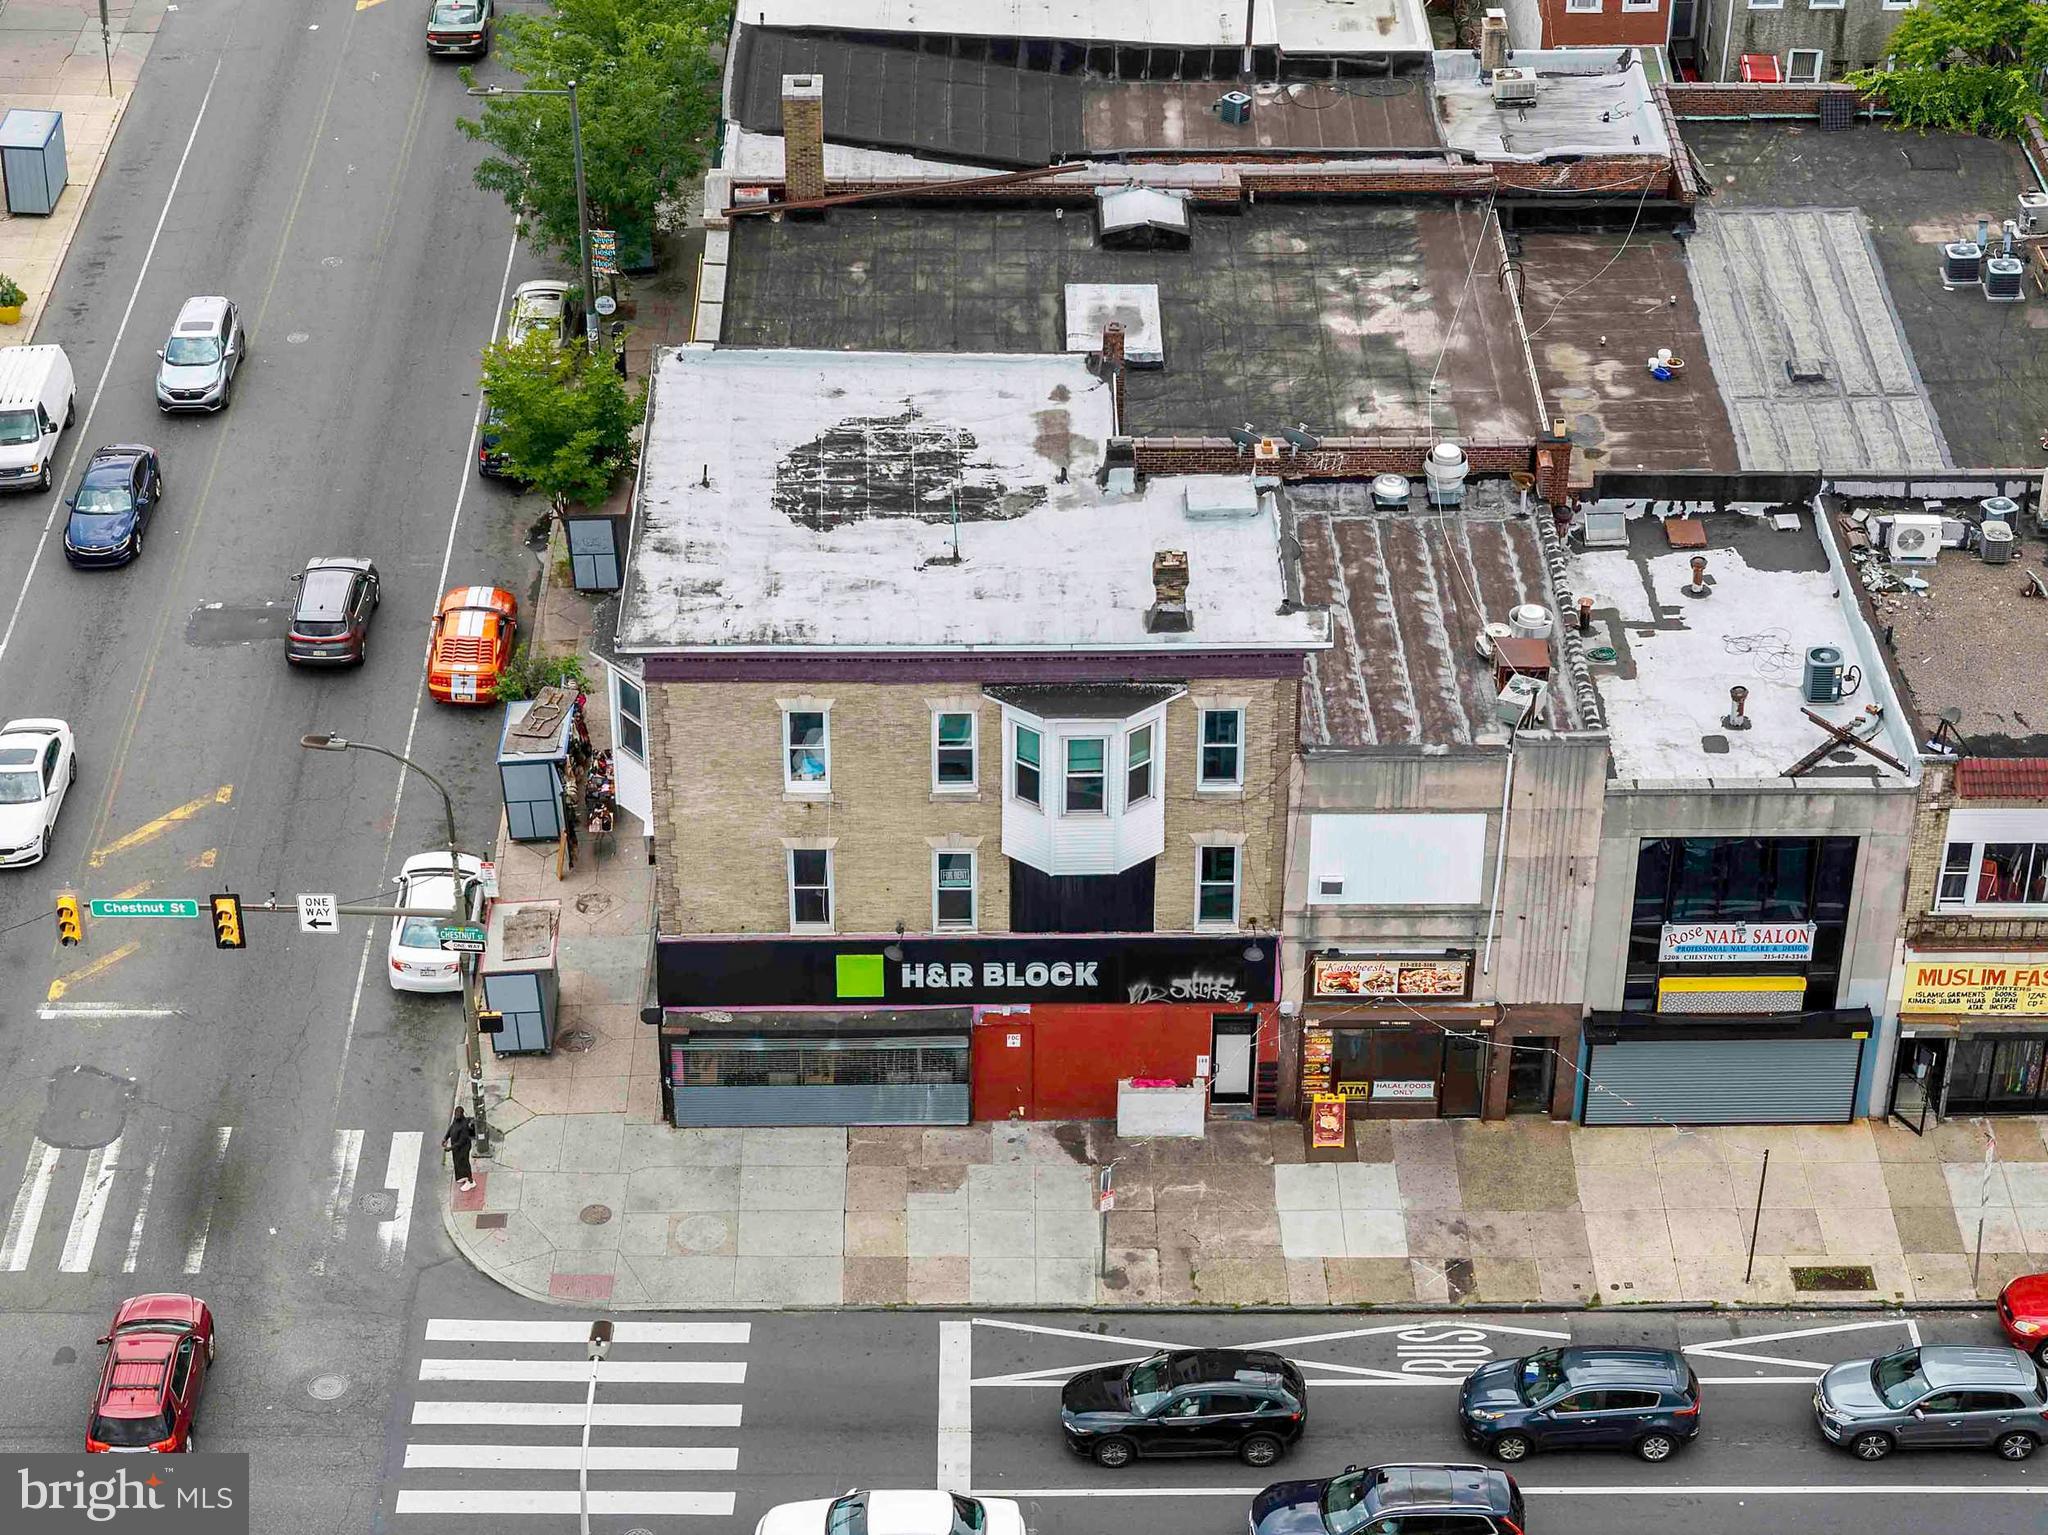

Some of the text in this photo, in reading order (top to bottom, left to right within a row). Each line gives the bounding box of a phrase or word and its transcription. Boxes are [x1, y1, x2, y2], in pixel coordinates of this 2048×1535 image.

[592, 236, 614, 244] Never
[305, 898, 329, 907] ONE
[103, 902, 186, 913] Chestnut St
[305, 908, 330, 917] WAY
[440, 931, 476, 940] CHESTNUT
[1665, 926, 1810, 948] Rose NAIL SALON
[1677, 945, 1727, 953] PROFESSIONAL
[1325, 962, 1386, 972] Kabobeesh
[901, 961, 1098, 988] H&R BLOCK
[1917, 968, 2007, 987] MUSLIM
[1339, 1086, 1367, 1095] ATM
[1397, 1329, 1494, 1373] BUS
